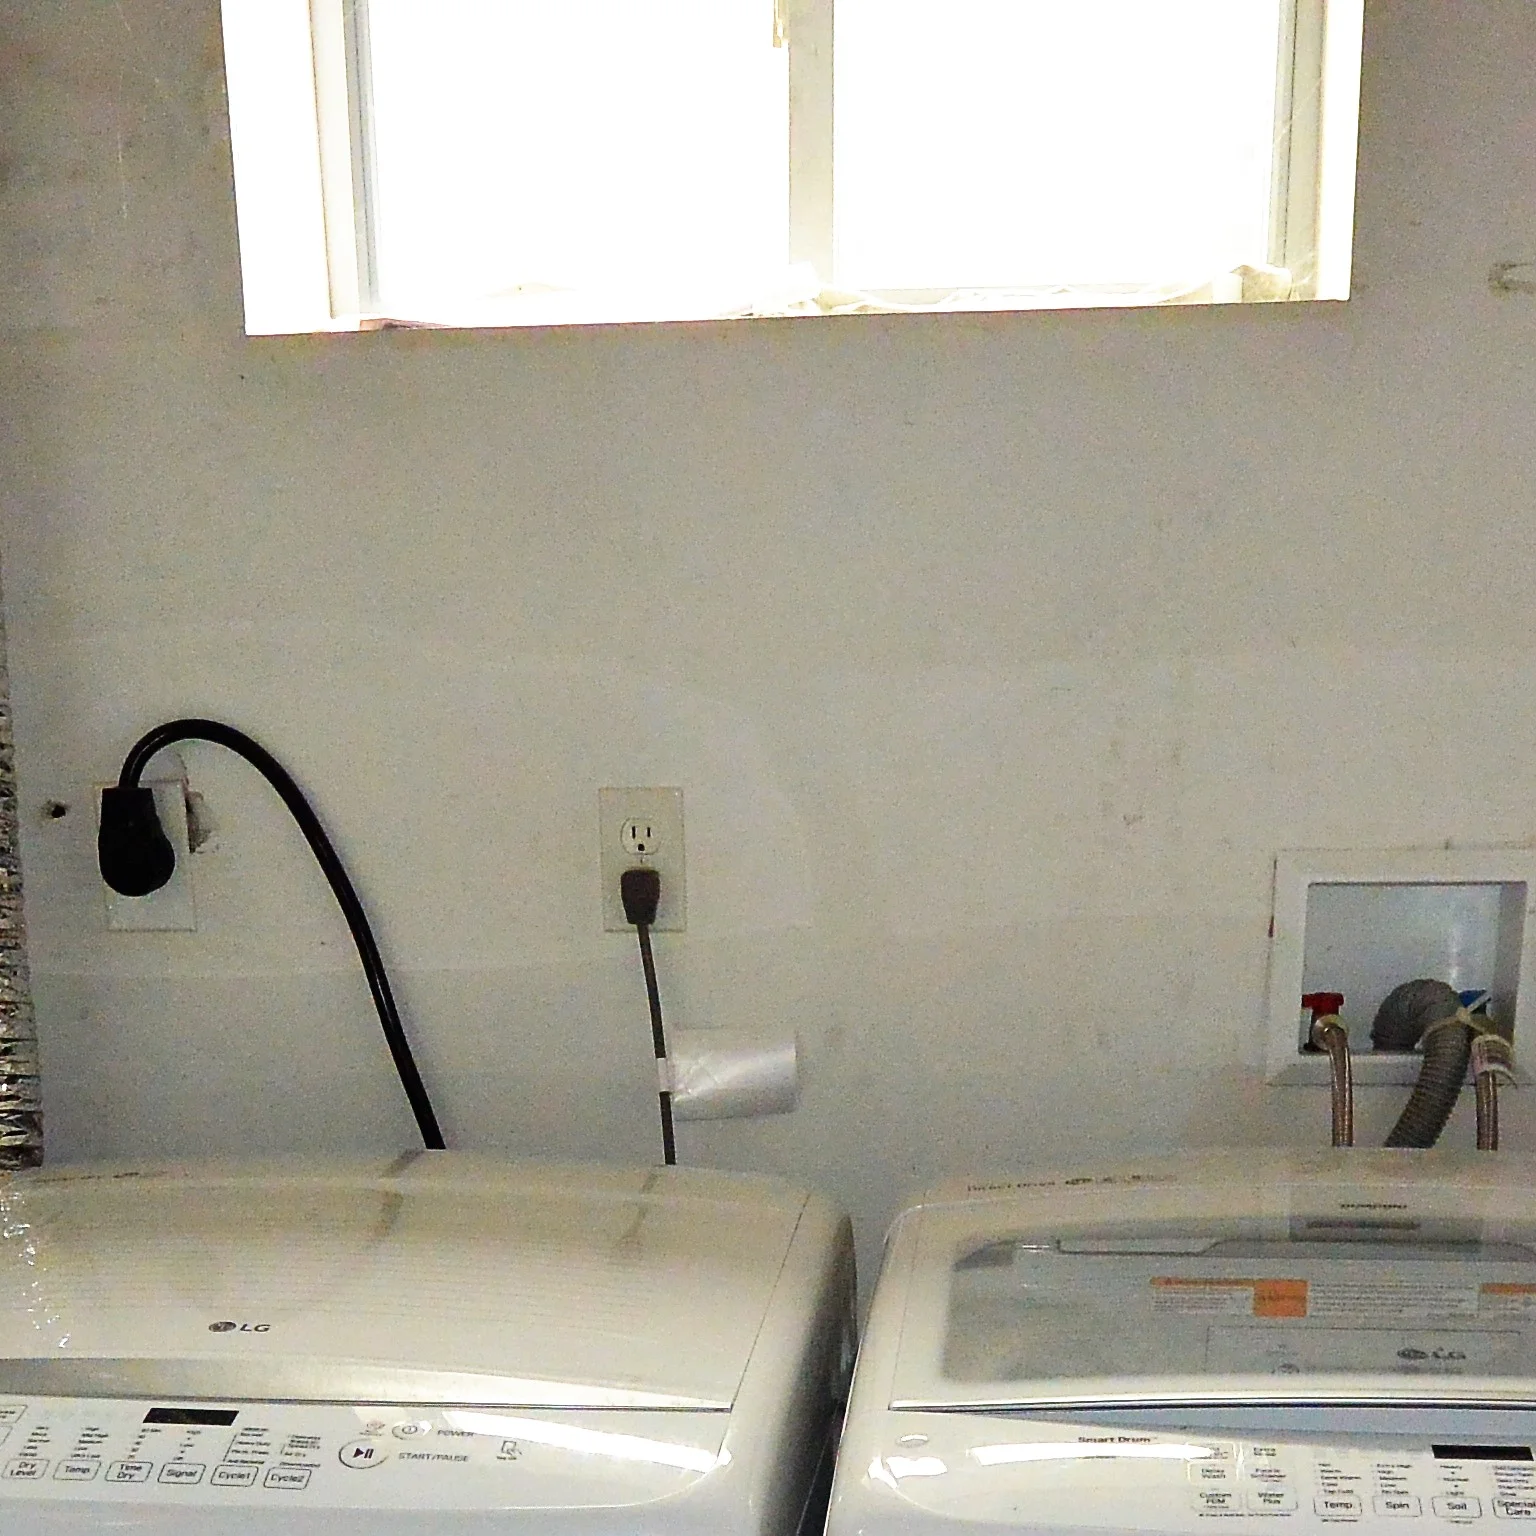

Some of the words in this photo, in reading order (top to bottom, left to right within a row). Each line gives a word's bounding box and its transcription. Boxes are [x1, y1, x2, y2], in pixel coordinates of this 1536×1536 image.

[239, 1323, 271, 1333] LG
[437, 1429, 475, 1437] POWER
[398, 1452, 470, 1462] START/PAUSE
[18, 1461, 37, 1470] Dry
[64, 1466, 91, 1474] Temp
[116, 1472, 136, 1480] Dry
[166, 1469, 198, 1478] Signal
[218, 1471, 251, 1480] Cycle1
[270, 1473, 306, 1483] Cycle2
[1323, 1501, 1354, 1510] Temp
[1385, 1501, 1410, 1510] Spin
[1446, 1502, 1468, 1511] Soil
[1496, 1500, 1536, 1508] Special
[1505, 1507, 1531, 1516] Care
